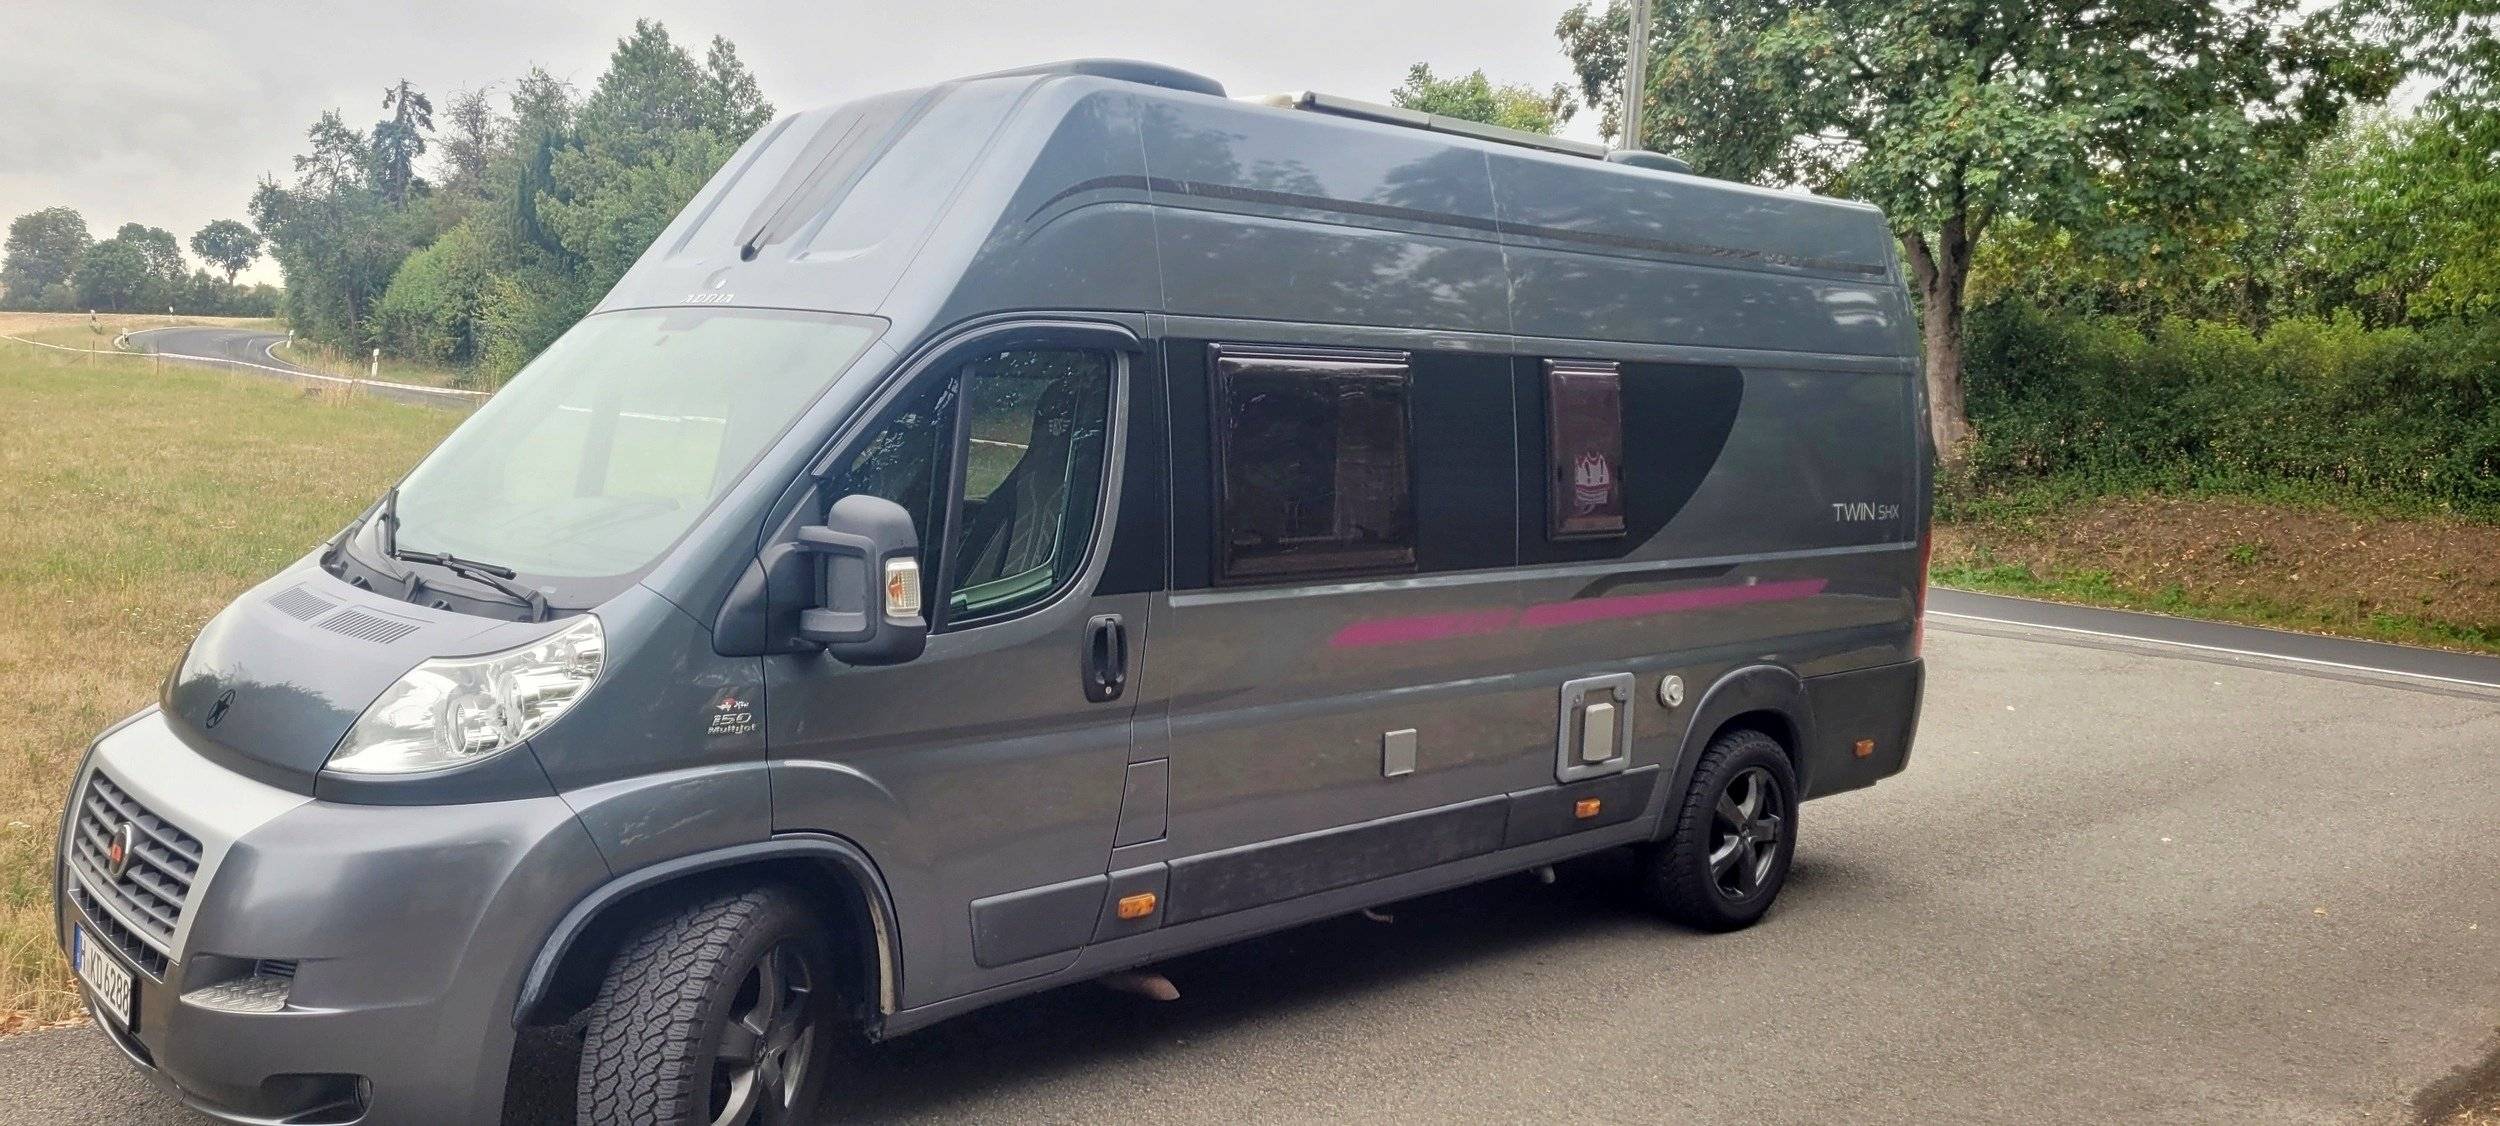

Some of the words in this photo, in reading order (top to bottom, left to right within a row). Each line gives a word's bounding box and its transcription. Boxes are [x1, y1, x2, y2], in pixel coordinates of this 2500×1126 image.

[1832, 502, 1876, 521] TWIN
[1878, 504, 1900, 520] SHX
[712, 712, 752, 726] 150
